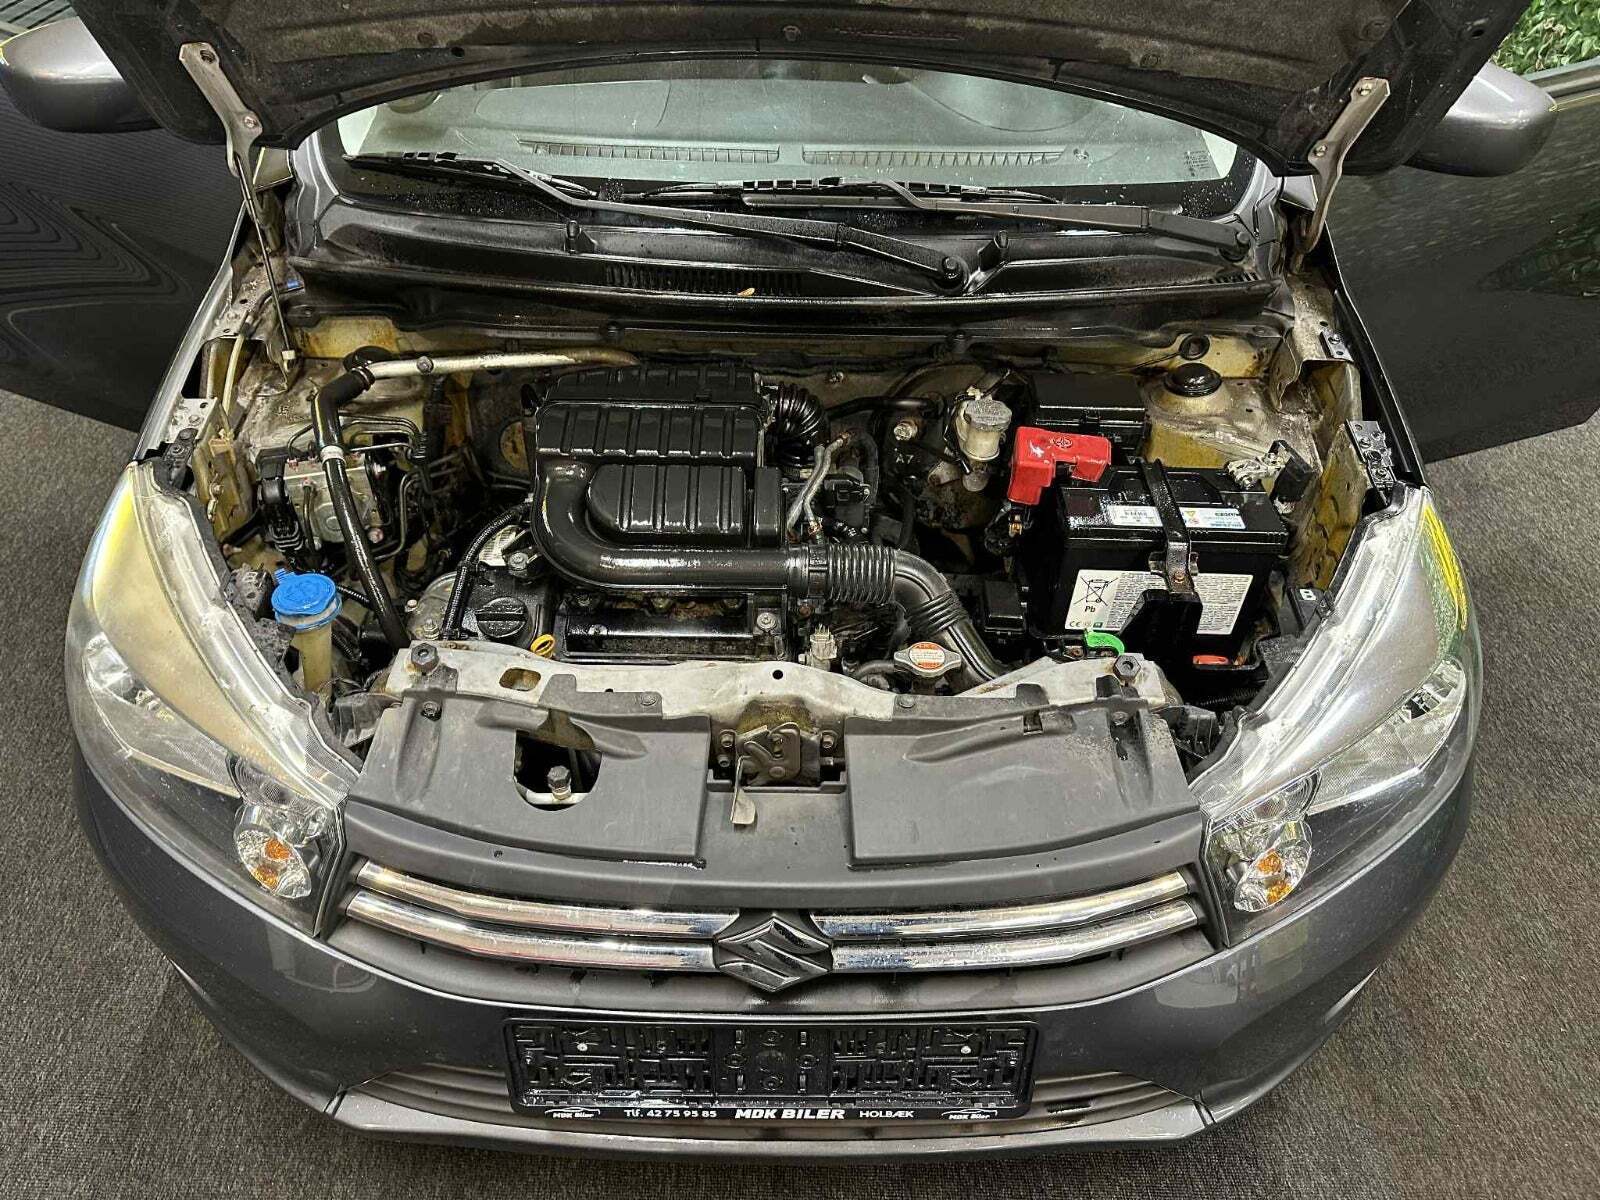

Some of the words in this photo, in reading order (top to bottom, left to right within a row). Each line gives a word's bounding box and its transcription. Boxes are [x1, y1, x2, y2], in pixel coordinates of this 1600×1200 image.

[1084, 605, 1096, 613] Pb
[624, 1109, 643, 1118] Tlf.
[646, 1110, 662, 1118] 42
[664, 1110, 680, 1118] 75
[684, 1110, 699, 1118] 95
[701, 1110, 717, 1118] 85
[735, 1108, 777, 1119] MDK
[781, 1108, 845, 1119] BILER
[859, 1110, 915, 1118] HOLBÆK
